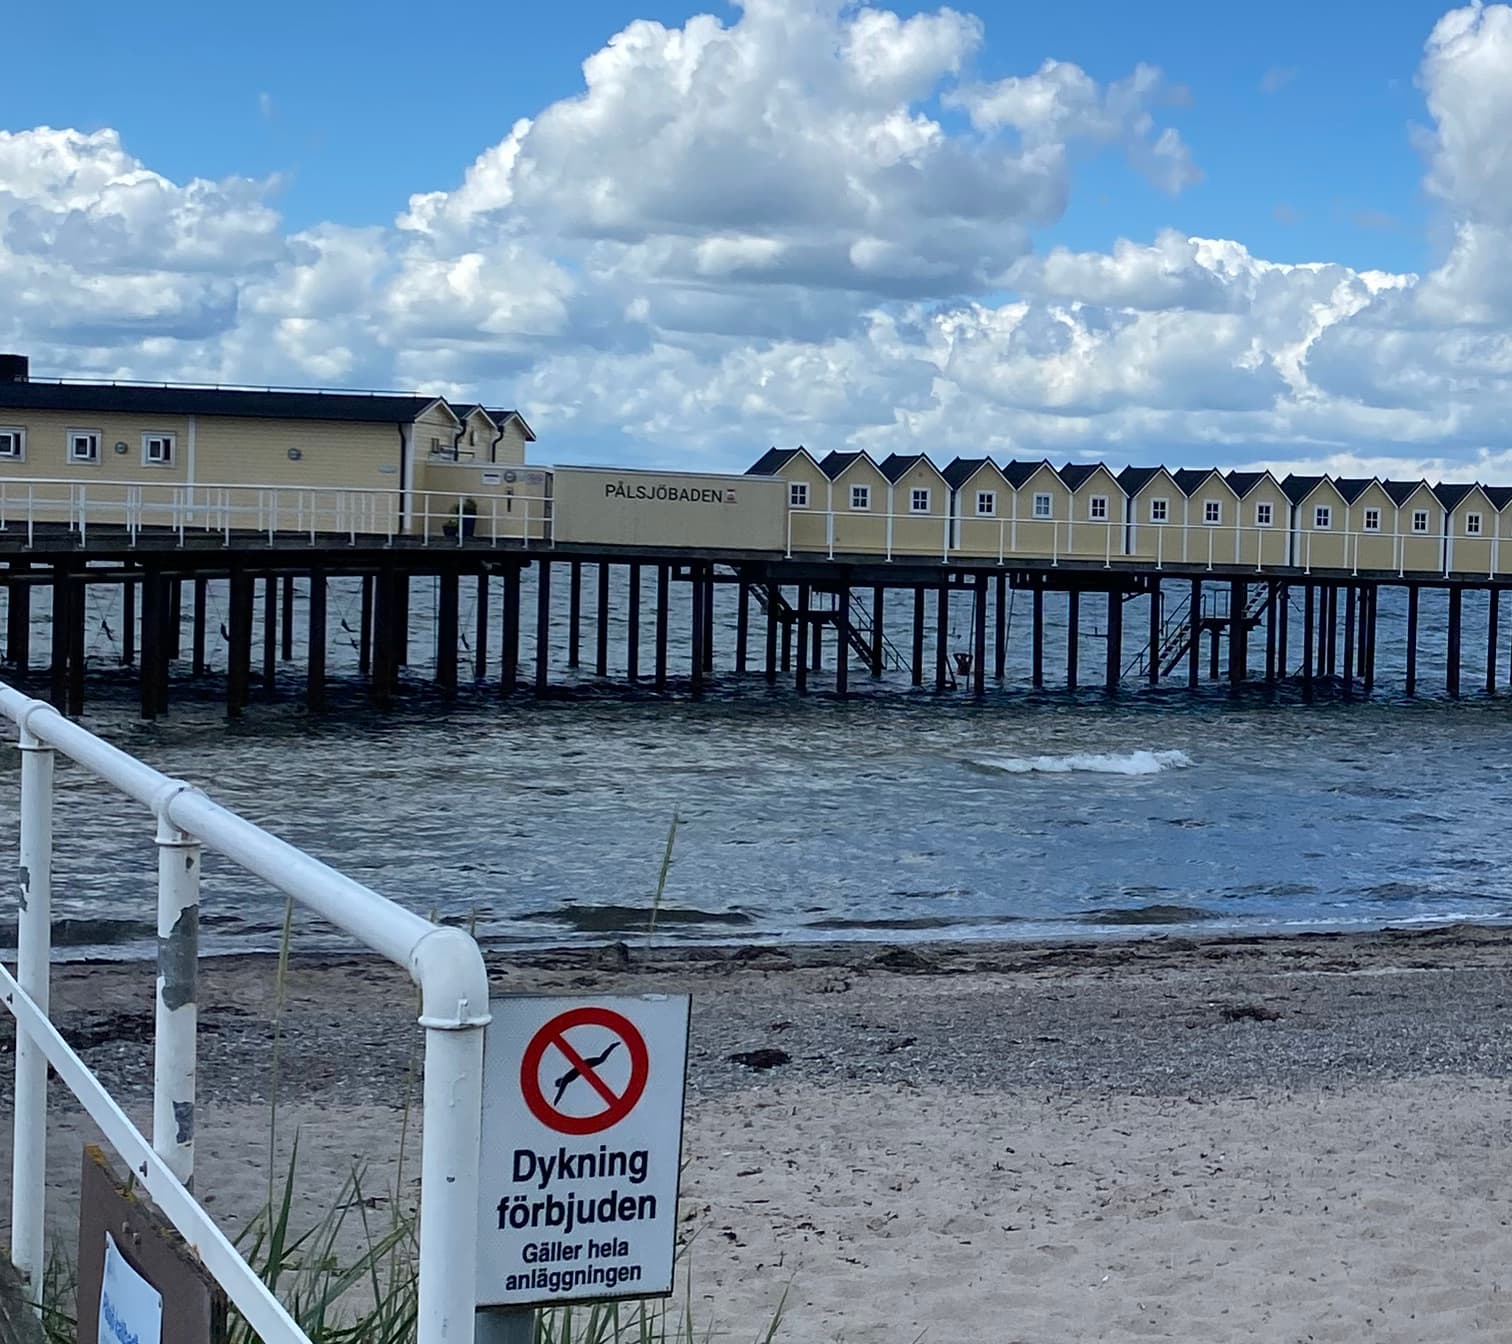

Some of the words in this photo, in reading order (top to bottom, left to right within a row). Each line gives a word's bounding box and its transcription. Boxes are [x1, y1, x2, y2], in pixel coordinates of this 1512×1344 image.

[605, 481, 723, 503] PÅLSJÖBADEN
[512, 1145, 649, 1189] Dykning
[497, 1190, 657, 1233] förbjuden
[522, 1242, 582, 1263] Gäller
[588, 1237, 629, 1259] hela
[505, 1264, 642, 1292] anläggningen
